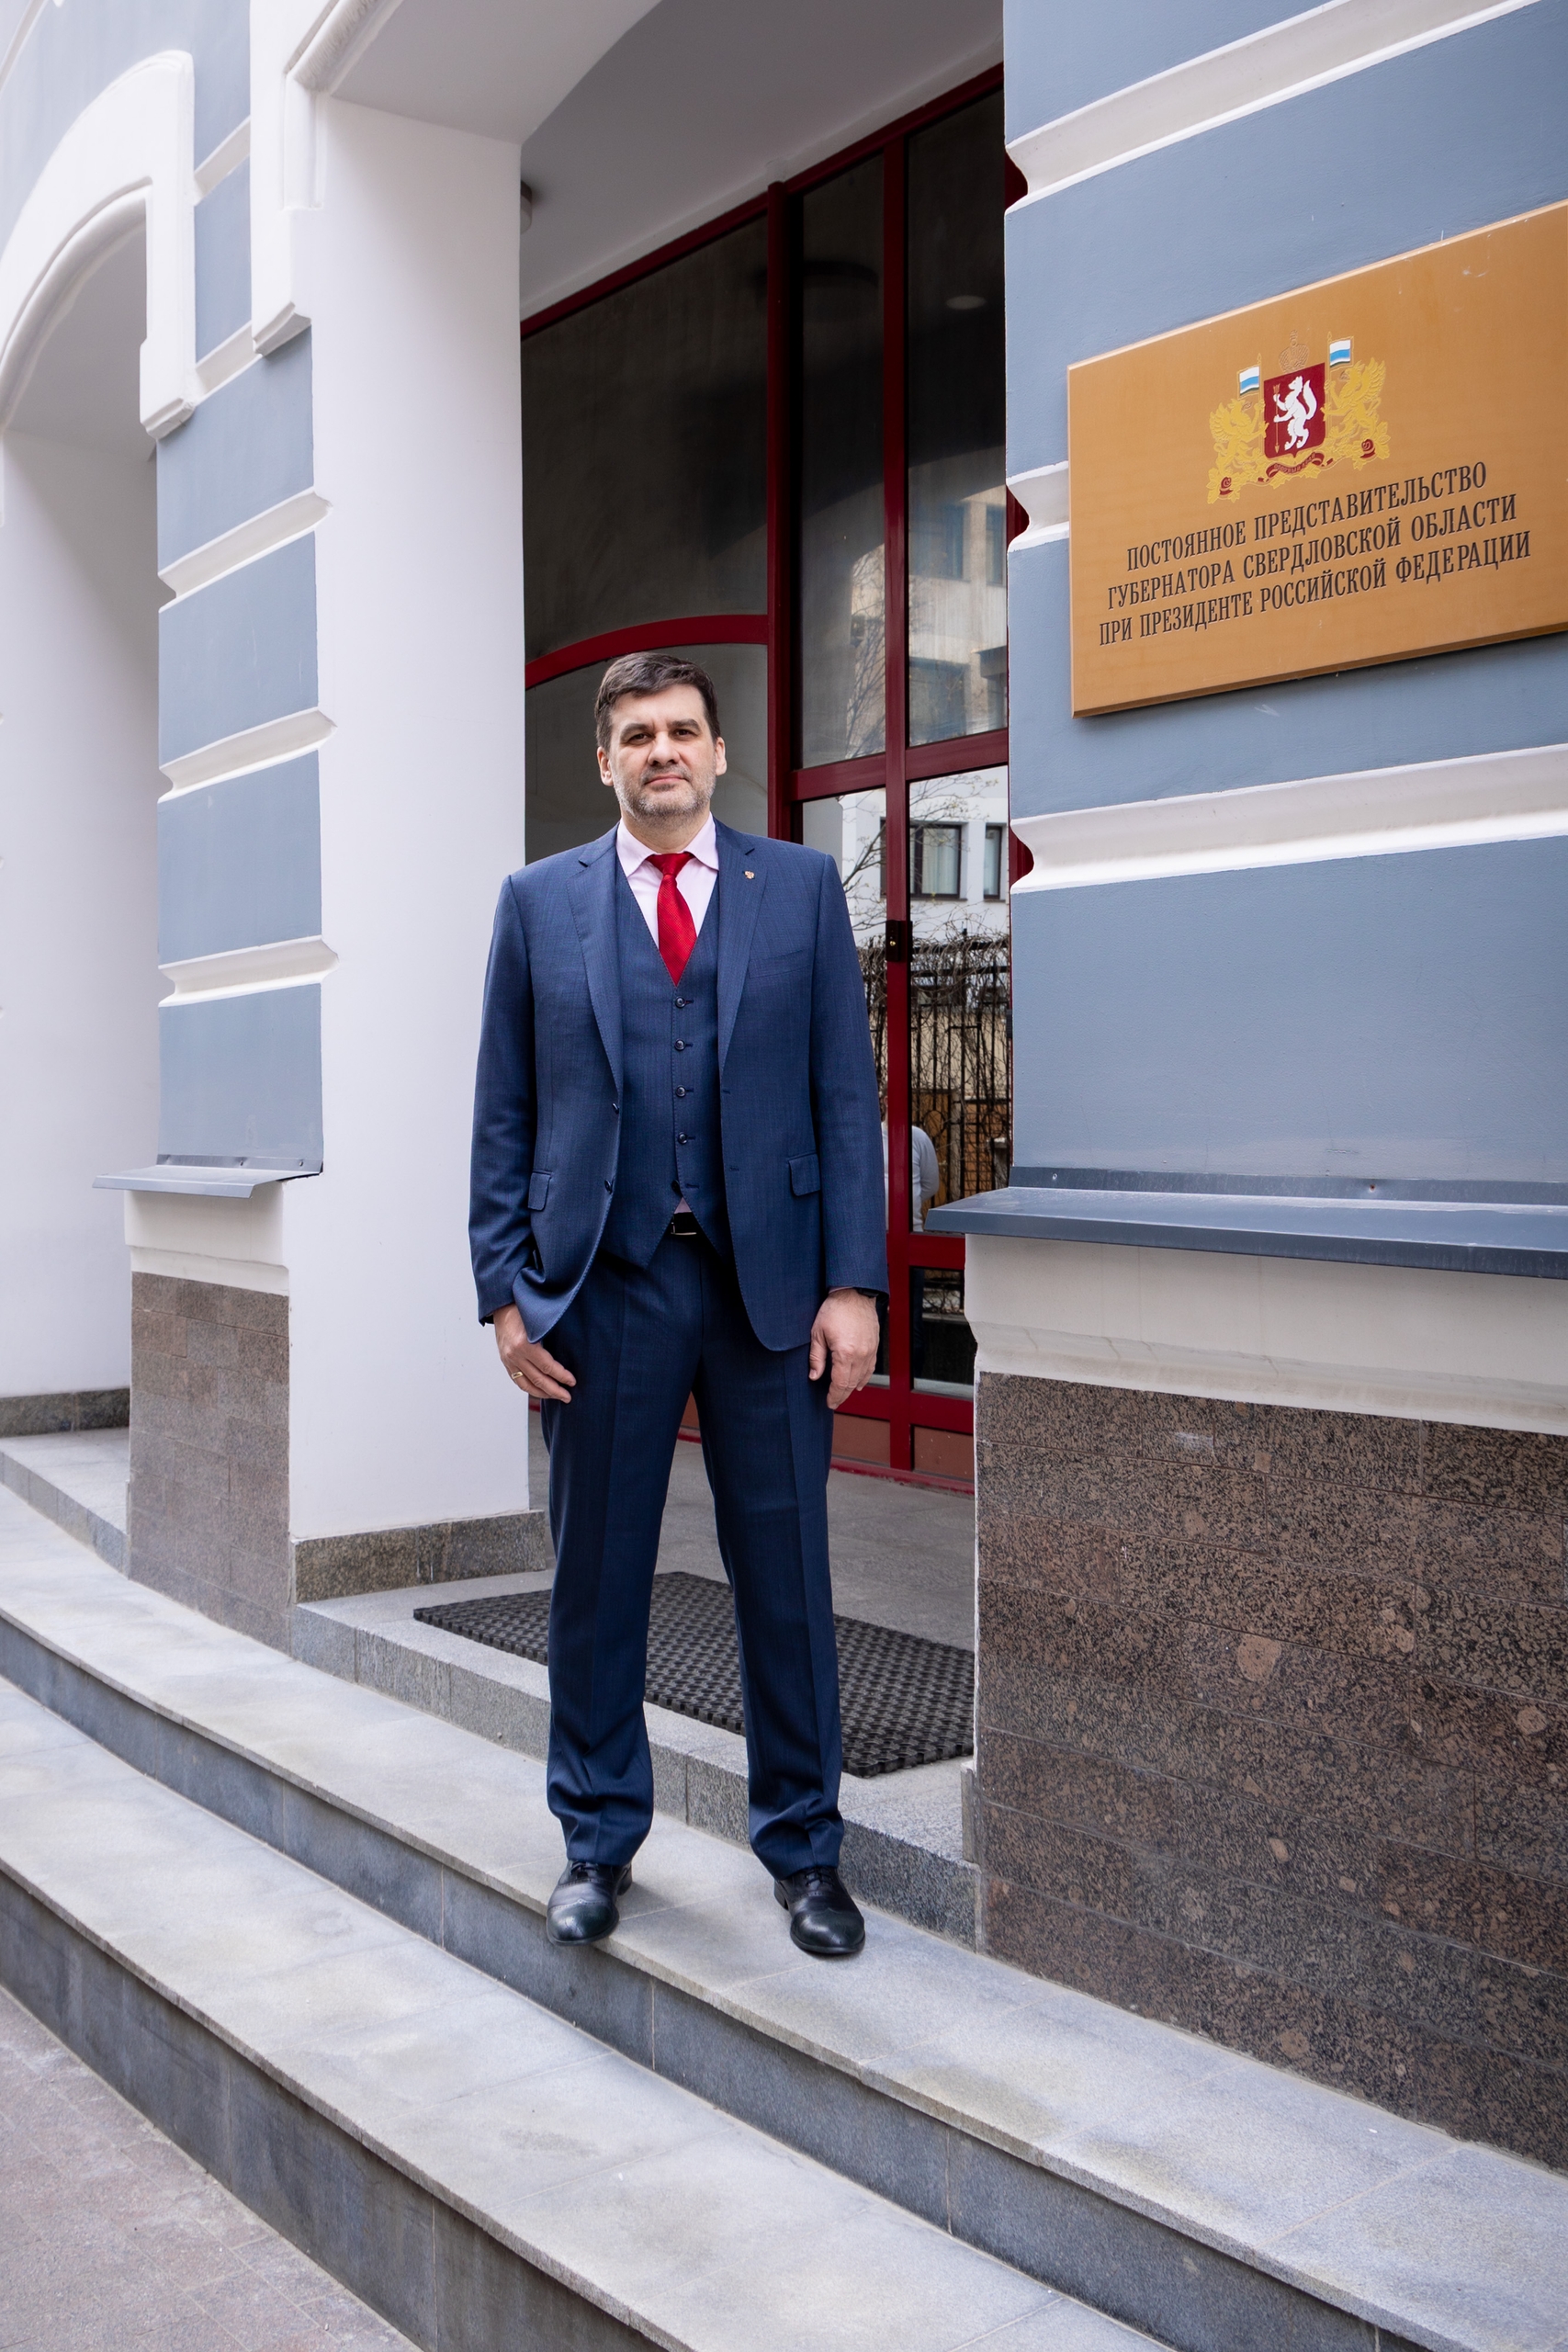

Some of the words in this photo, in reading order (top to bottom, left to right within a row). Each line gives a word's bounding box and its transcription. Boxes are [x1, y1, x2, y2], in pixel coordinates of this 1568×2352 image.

[1108, 560, 1235, 610] ГУБЕРНАТОРА
[1243, 516, 1402, 579] СВЕРДЛОВСКОЙ
[1411, 493, 1517, 542] ОБЛАСТИ
[1127, 520, 1247, 571] ПОСТОЯННОЕ
[1254, 461, 1487, 541] ПРЕДСТАВИТЕЛЬСТВО
[1100, 617, 1133, 646] ПРИ
[1140, 591, 1253, 638] ПРЕЗИДЕНТЕ
[1260, 558, 1387, 613] РОССИЙСКОЙ
[1395, 531, 1531, 584] ФЕДЕРАЦИИ
